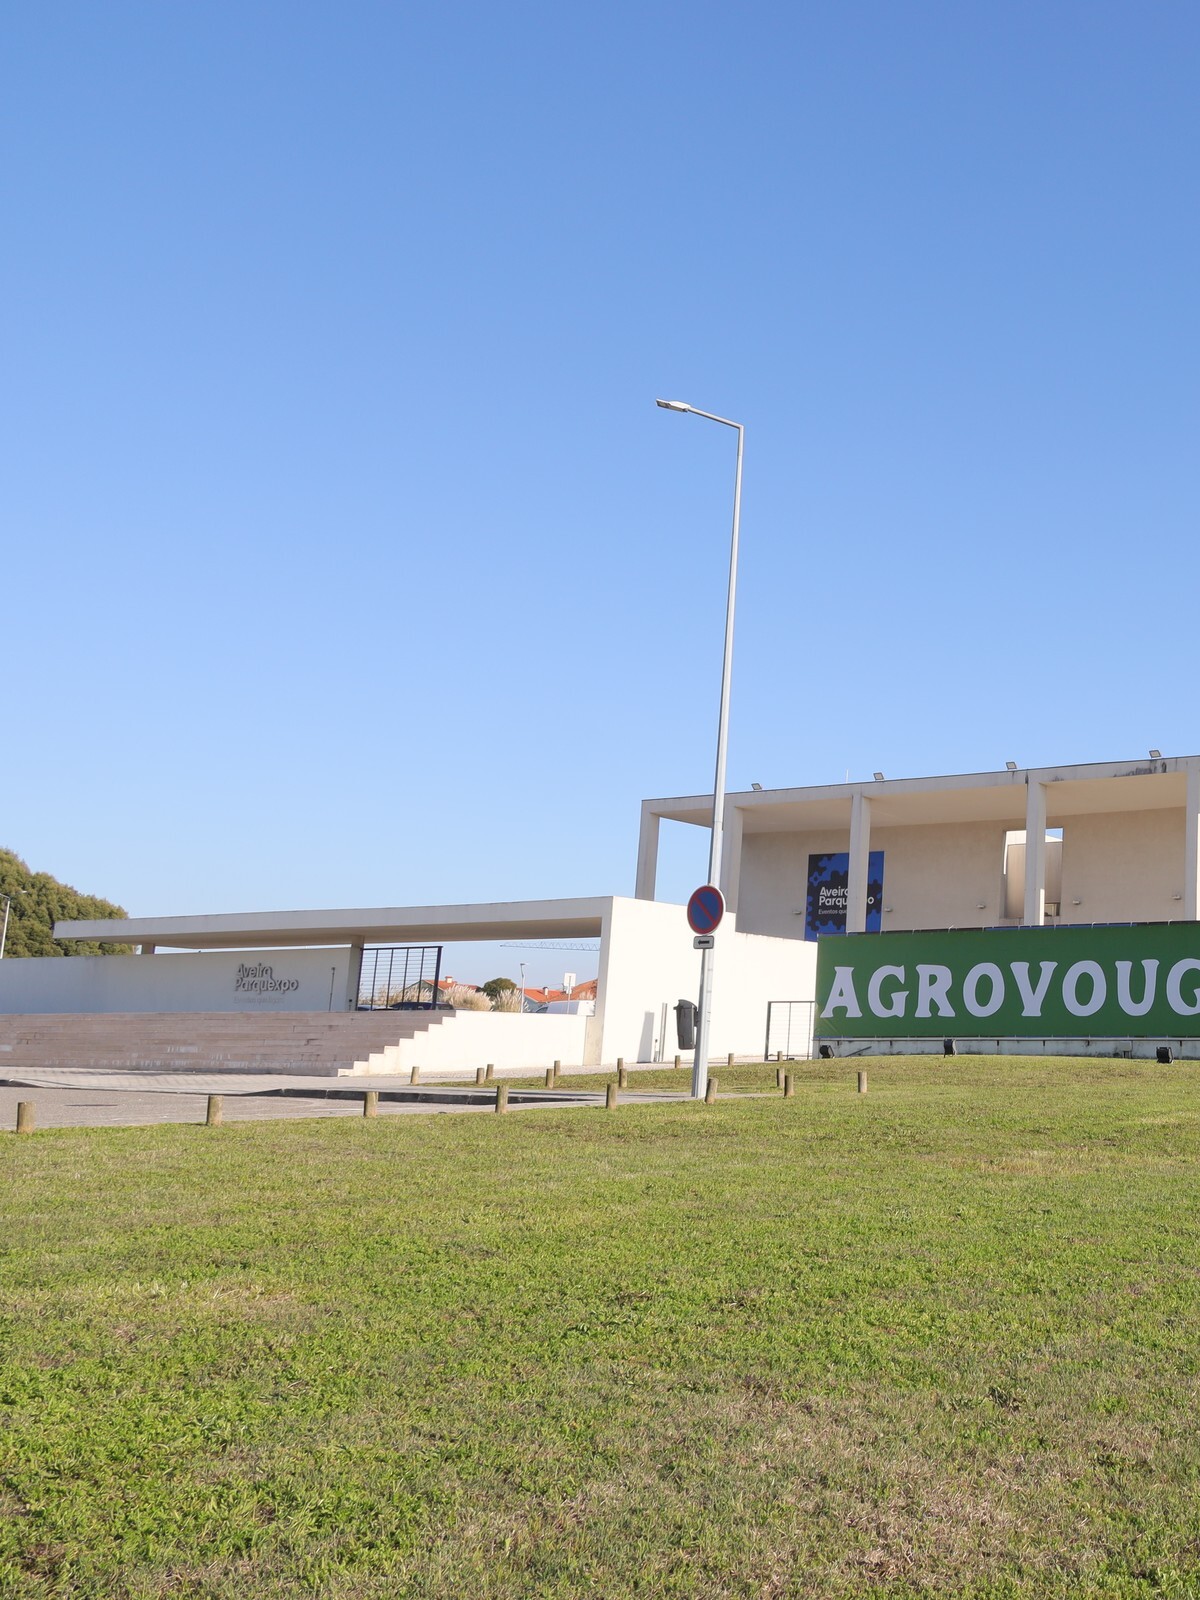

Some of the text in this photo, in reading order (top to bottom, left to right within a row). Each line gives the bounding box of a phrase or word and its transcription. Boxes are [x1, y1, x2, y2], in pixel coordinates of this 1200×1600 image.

[819, 896, 875, 907] Parquo
[237, 963, 273, 978] Aveiro
[235, 977, 299, 995] Parquexpo
